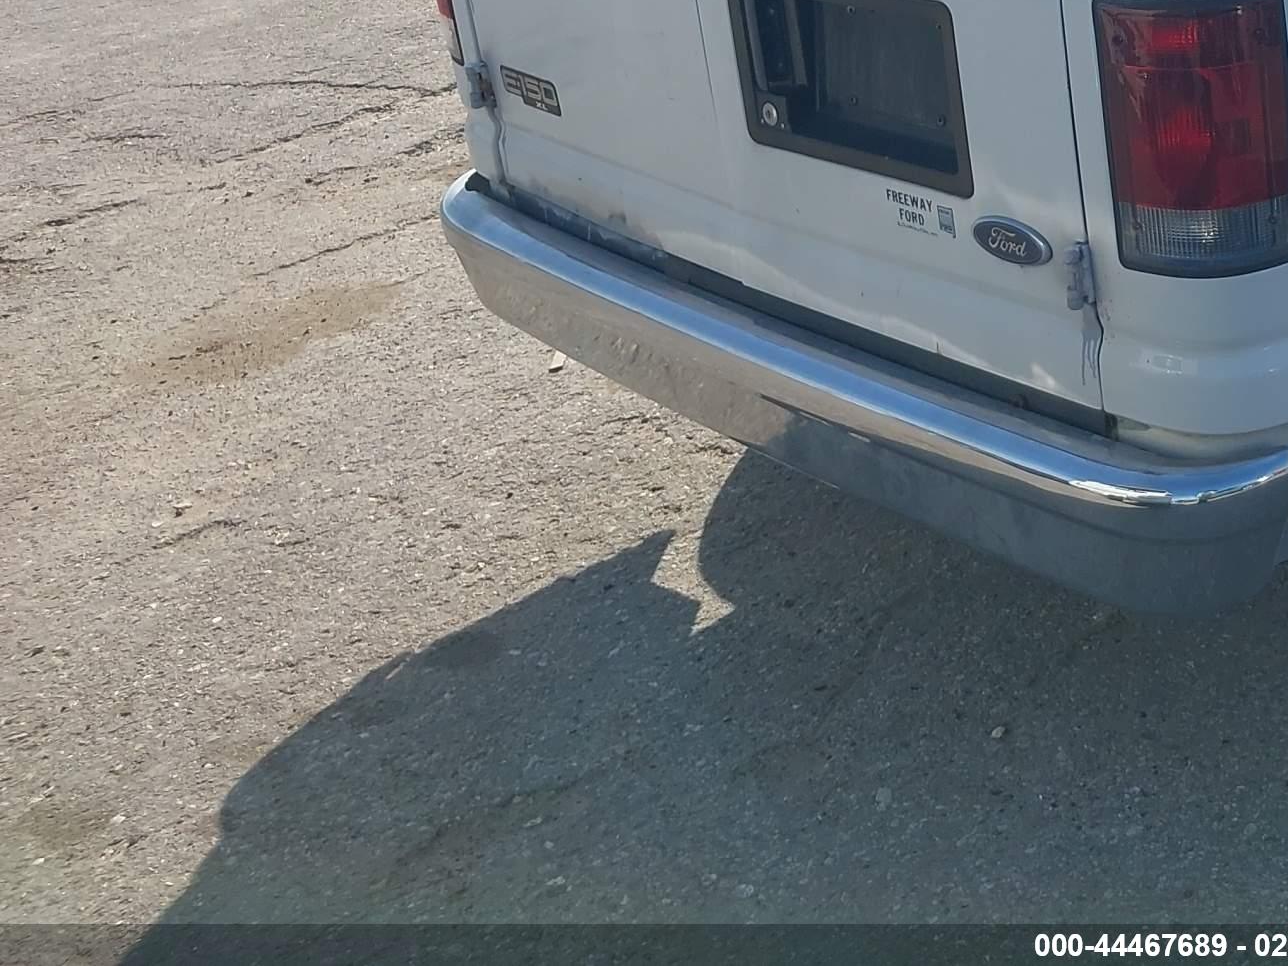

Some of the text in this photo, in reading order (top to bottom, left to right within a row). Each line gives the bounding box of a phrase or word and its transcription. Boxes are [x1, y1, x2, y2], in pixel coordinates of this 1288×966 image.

[886, 189, 933, 213] FREEWAY
[899, 208, 925, 227] FORD
[988, 226, 1027, 257] Ford
